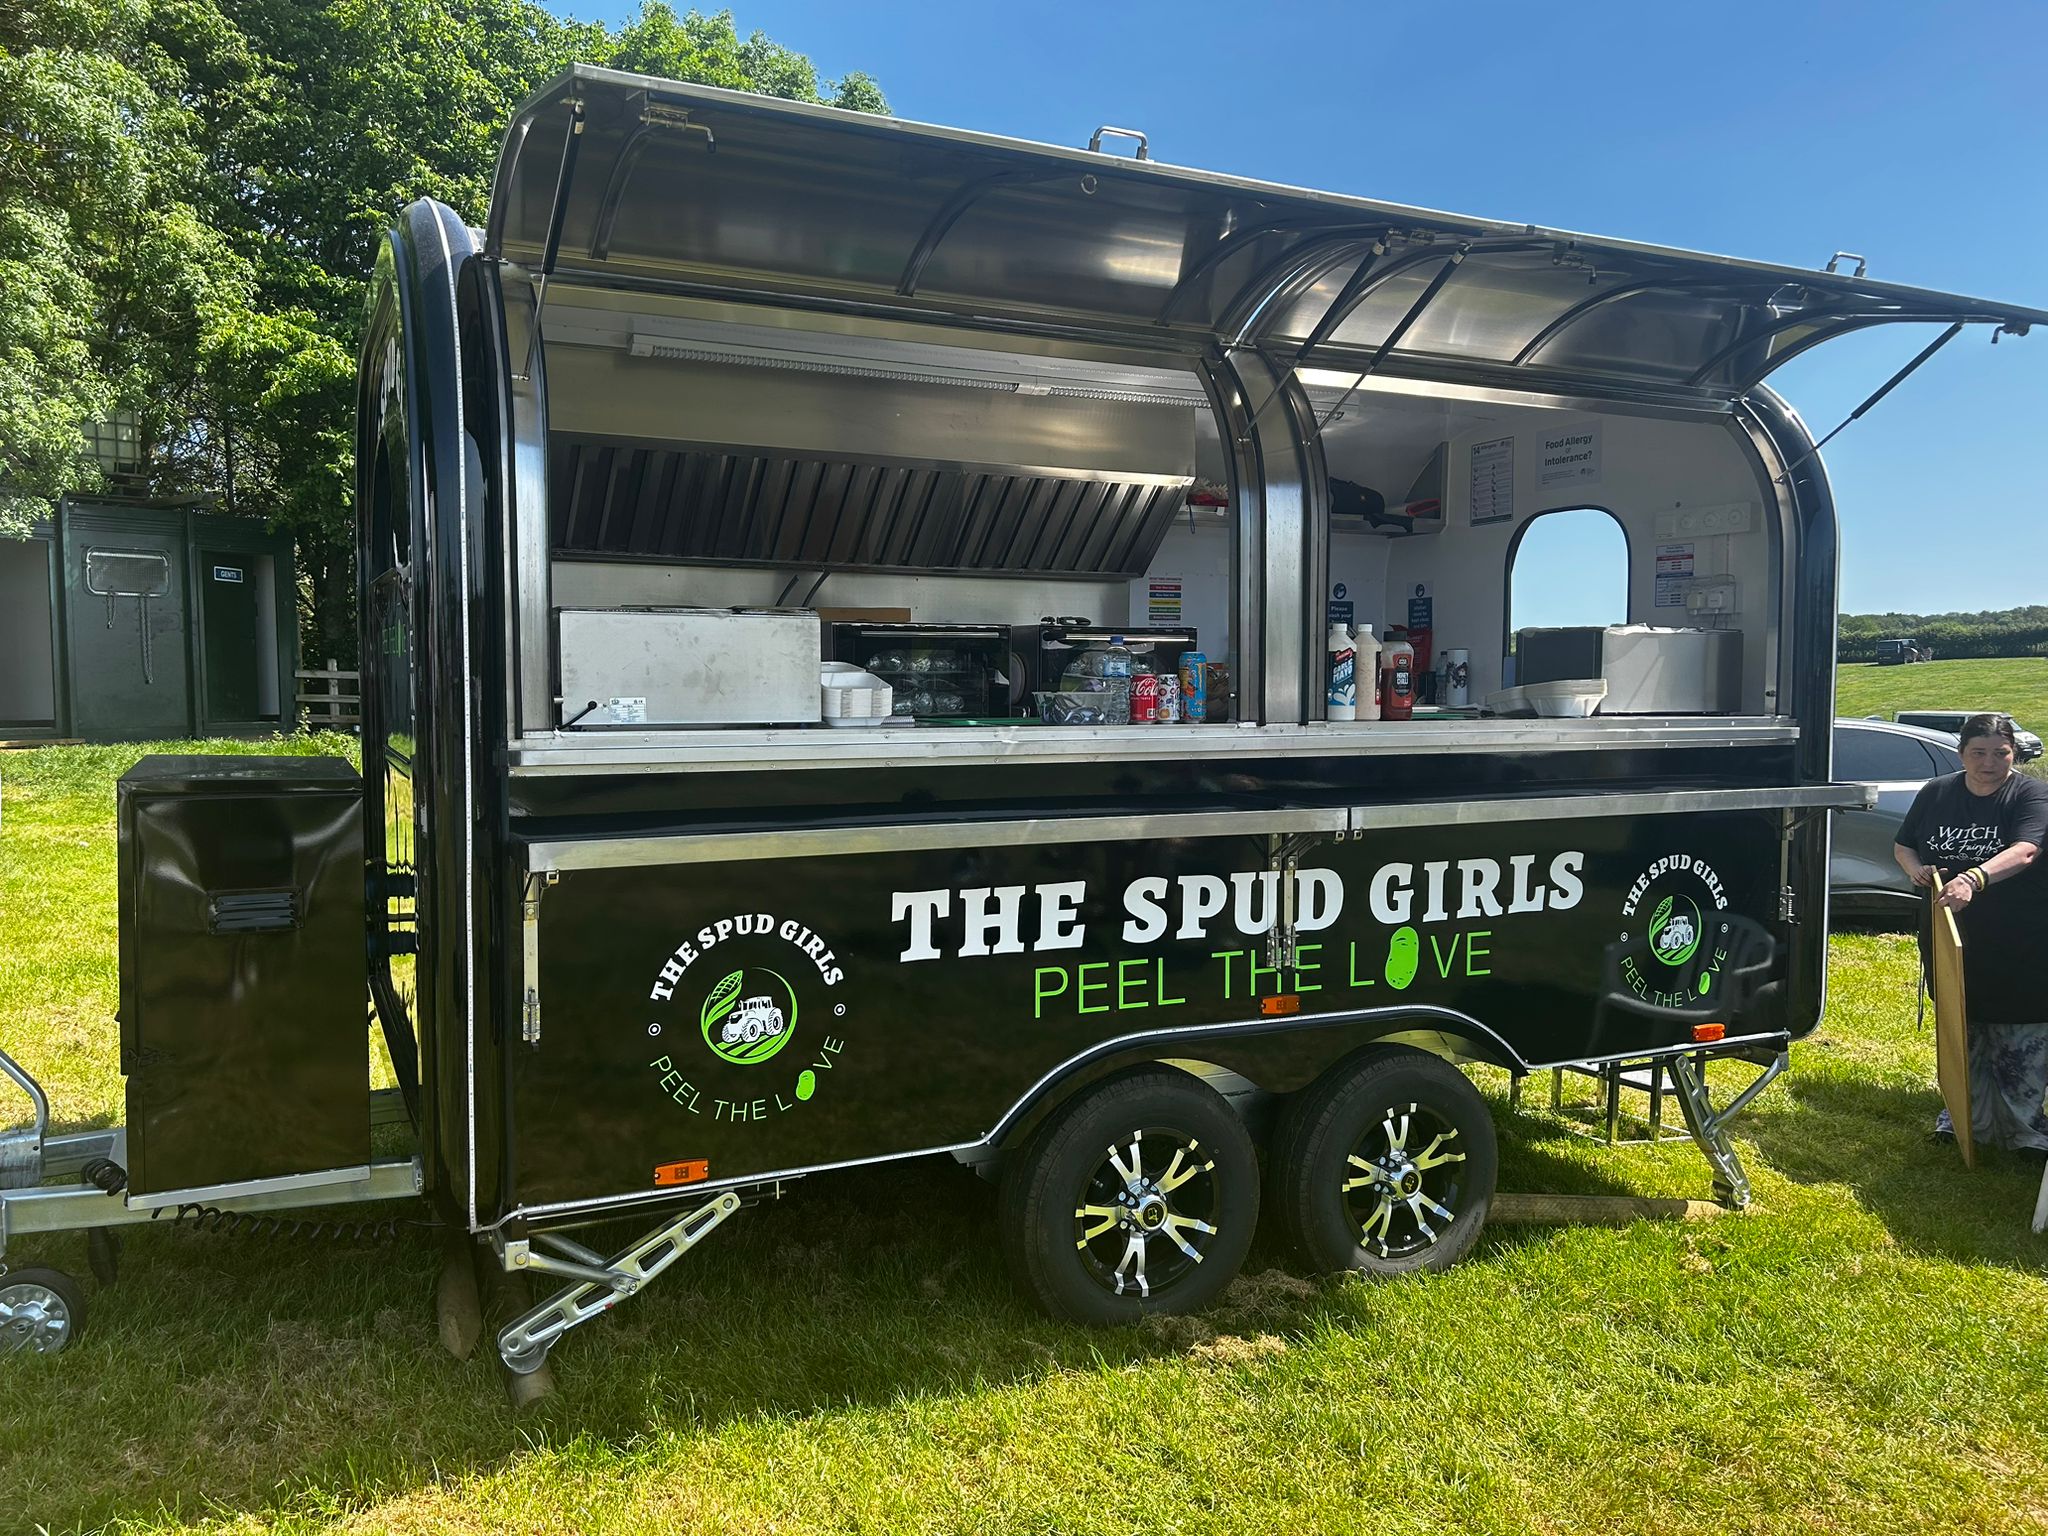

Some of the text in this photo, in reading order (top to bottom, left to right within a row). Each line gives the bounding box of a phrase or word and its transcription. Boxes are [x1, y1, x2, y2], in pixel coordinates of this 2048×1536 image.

[1544, 450, 1593, 467] Intolerance?
[1545, 434, 1593, 450] Food Allergy
[220, 570, 237, 579] GENTS
[1333, 665, 1353, 683] MAYO
[1939, 826, 1998, 840] WITCH
[1940, 836, 1955, 851] &
[1622, 854, 1729, 917] THE SPUD GIRLS
[891, 851, 1586, 963] THE SPUD GIRLS
[650, 913, 845, 1001] THE SPUD GIRLS
[1034, 956, 1186, 1019] PEEL
[1211, 943, 1324, 1000] THE
[1620, 956, 1650, 1001] PEEL
[1654, 990, 1683, 1008] THE
[649, 1055, 703, 1115] PEEL
[713, 1098, 767, 1122] THE
